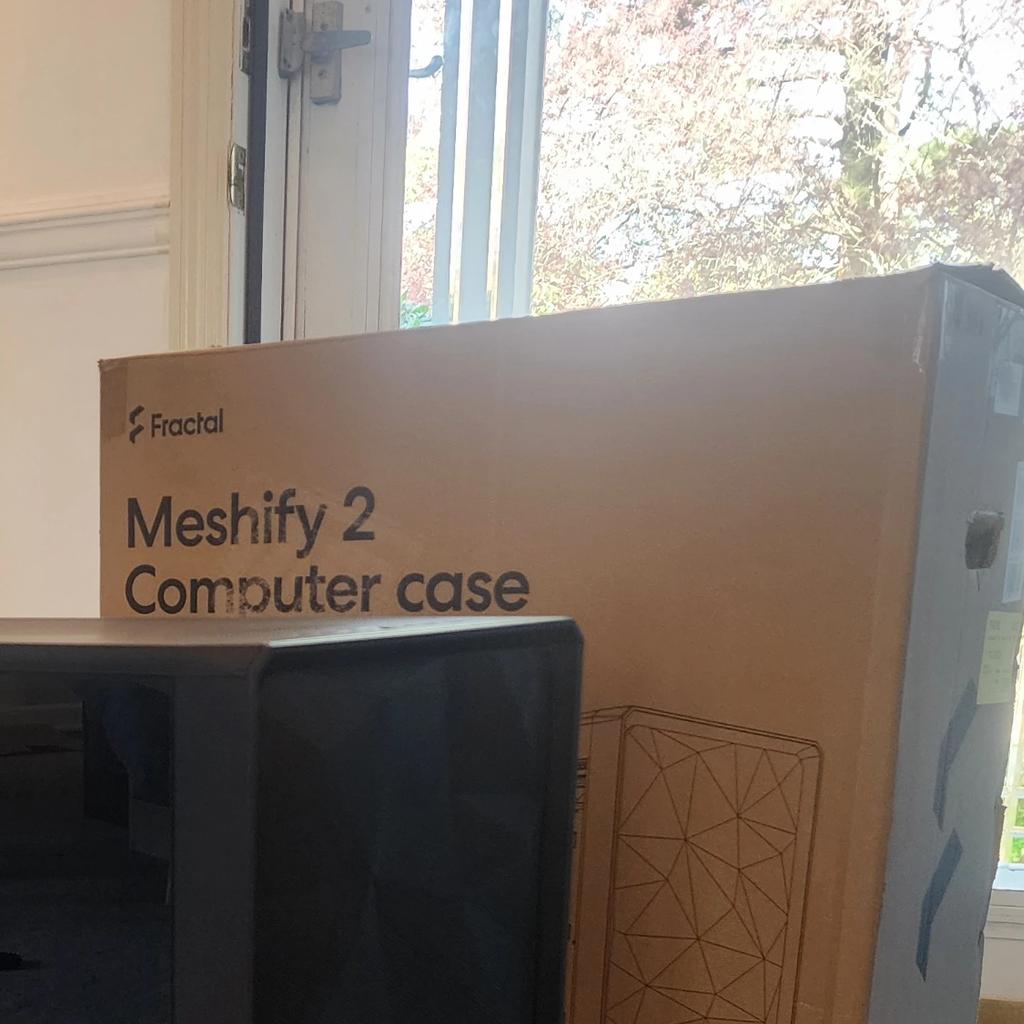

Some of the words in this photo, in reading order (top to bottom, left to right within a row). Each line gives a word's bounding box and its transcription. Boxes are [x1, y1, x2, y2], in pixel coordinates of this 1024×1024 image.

[150, 407, 224, 438] Fractal
[127, 488, 327, 559] Meshify
[342, 486, 376, 541] 2
[125, 564, 381, 615] Computer
[396, 570, 530, 613] case
